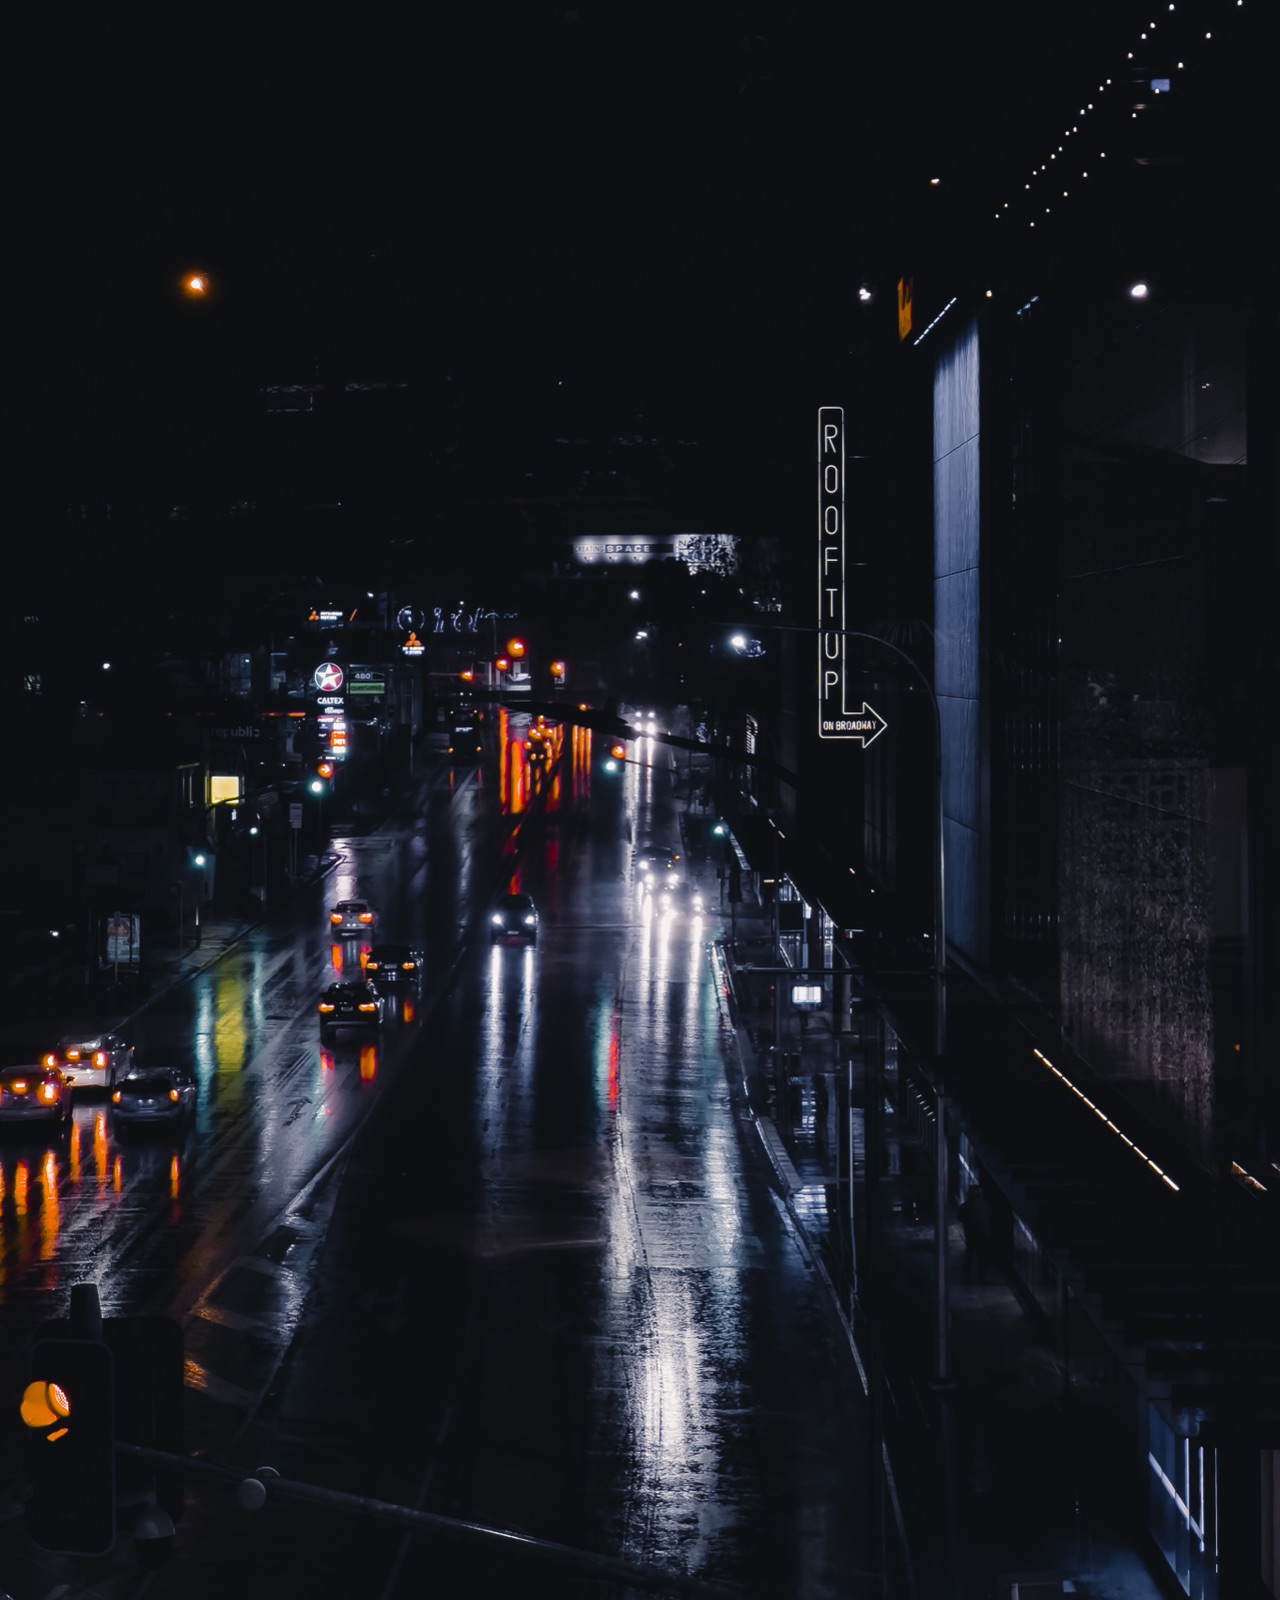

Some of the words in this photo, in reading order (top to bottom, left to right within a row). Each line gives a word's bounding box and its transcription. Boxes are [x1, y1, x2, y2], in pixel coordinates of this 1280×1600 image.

[607, 545, 650, 553] SPACE
[824, 423, 839, 700] ROOFTOP
[317, 697, 344, 705] CALTEX
[822, 720, 834, 731] ON
[835, 720, 877, 731] BROADWAY
